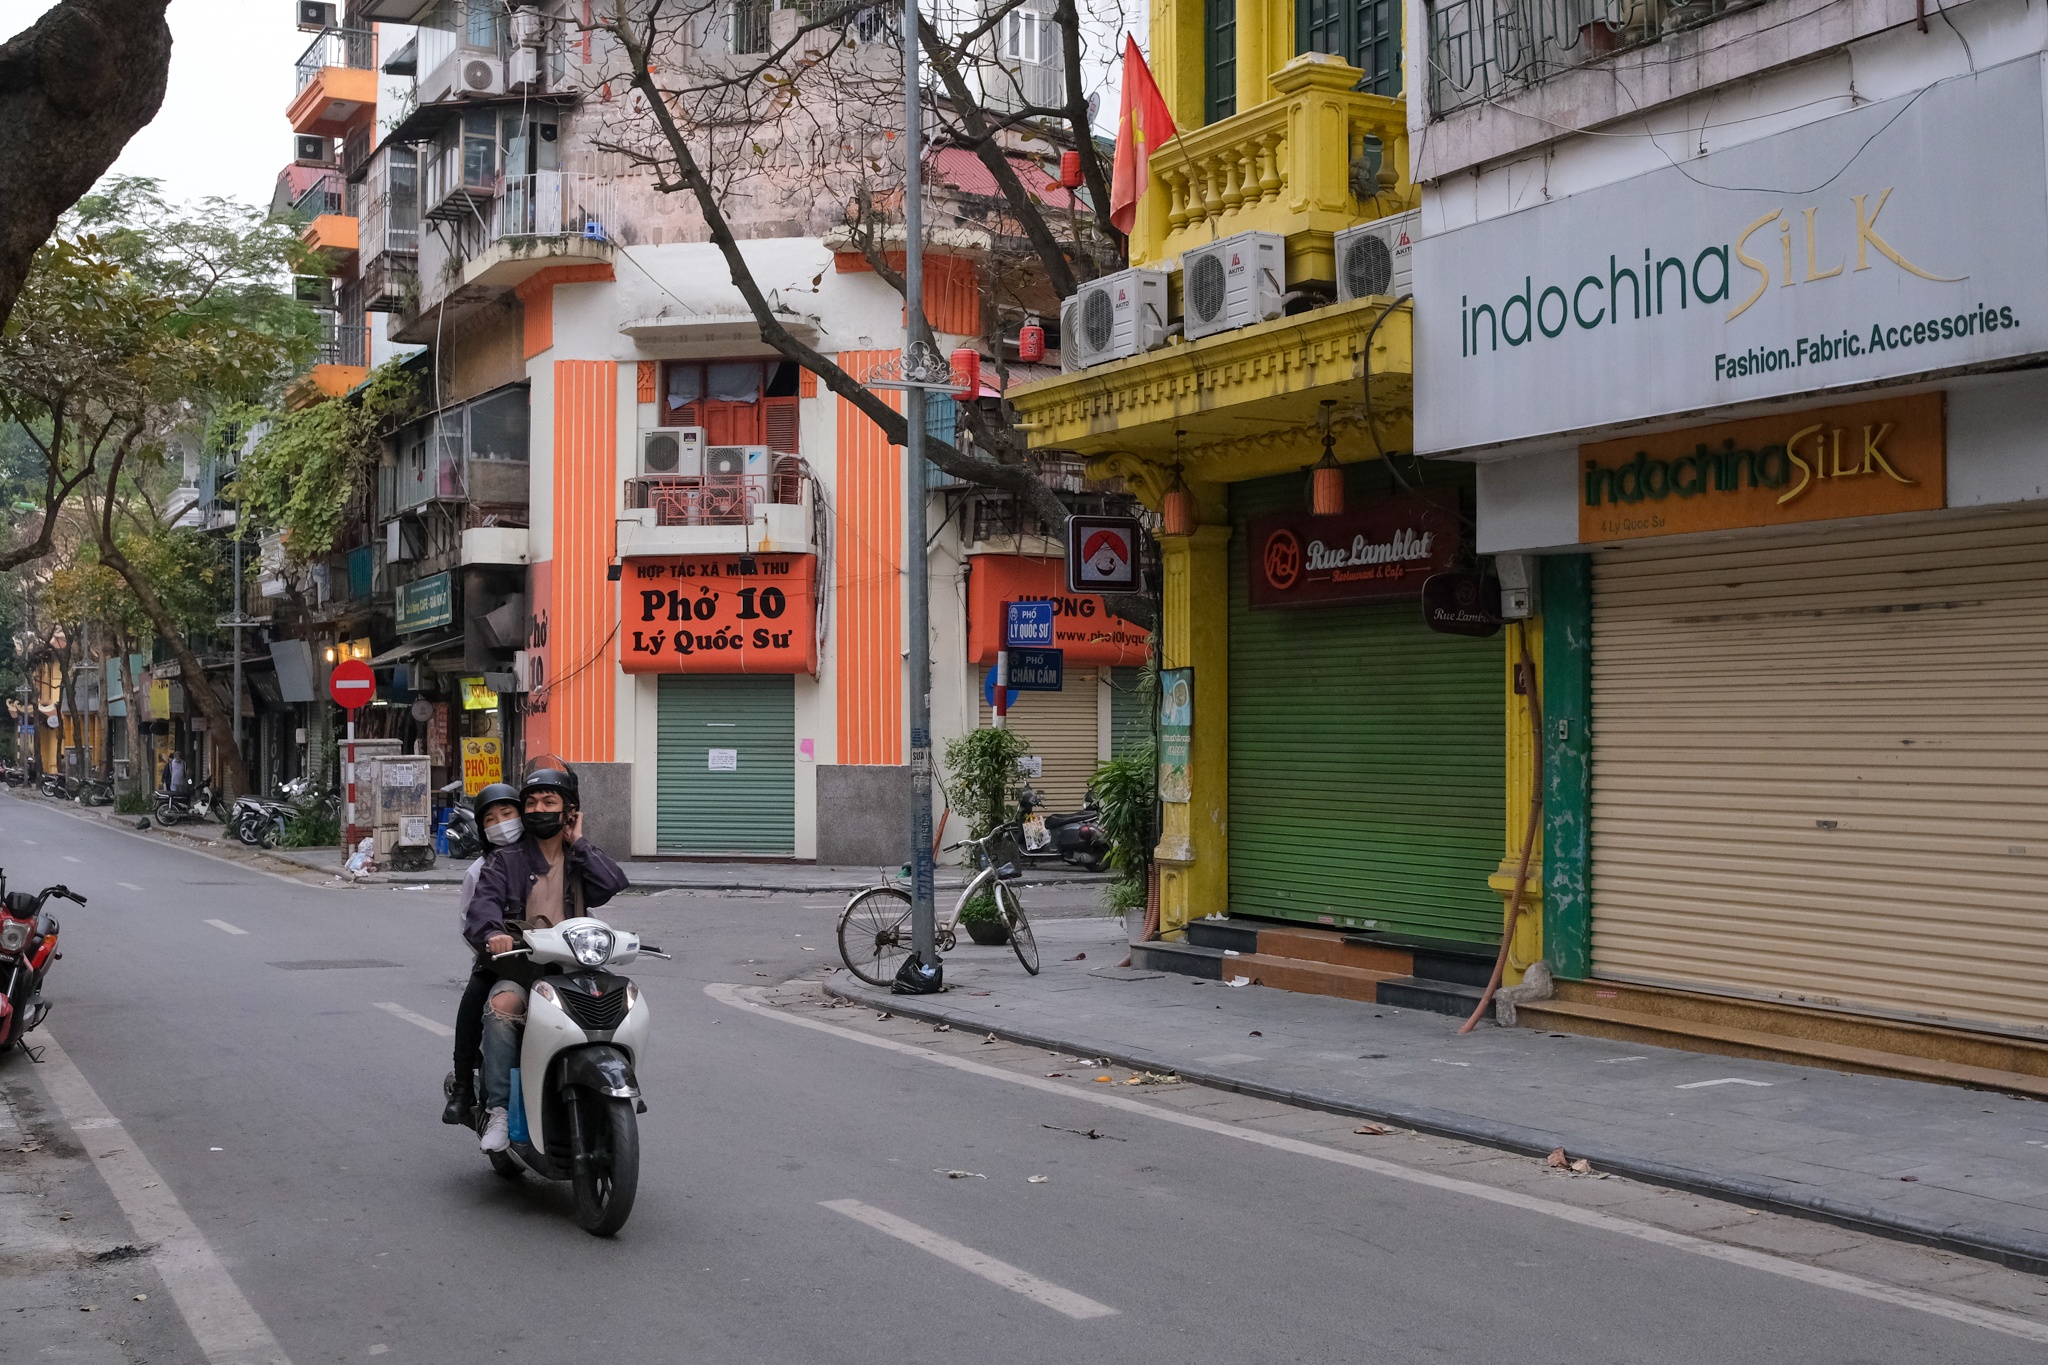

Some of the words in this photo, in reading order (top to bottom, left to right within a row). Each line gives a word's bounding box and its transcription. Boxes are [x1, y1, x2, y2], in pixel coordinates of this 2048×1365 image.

[1396, 246, 1412, 256] AKIT
[1228, 266, 1245, 276] AKITO
[1116, 301, 1130, 310] AKITO
[1305, 540, 1345, 570] Rue
[1348, 527, 1430, 566] Lamblot
[638, 564, 664, 580] HỢP
[671, 563, 696, 578] TÁC
[701, 562, 720, 576] XÃ
[762, 562, 790, 574] THU
[1332, 568, 1375, 582] Restaurant
[640, 586, 720, 622] Phở
[736, 586, 786, 620] 10
[1019, 595, 1096, 618] ƠNG
[1022, 607, 1037, 619] PHỐ
[1433, 608, 1455, 620] Rue
[1010, 620, 1018, 638] LÝ
[1020, 620, 1037, 638] QUỐC
[1039, 623, 1049, 638] SƯ
[632, 630, 666, 656] Lý
[674, 626, 744, 655] Quốc
[753, 628, 792, 649] Sư
[1026, 654, 1044, 664] PHỐ
[465, 754, 485, 777] PHỞ
